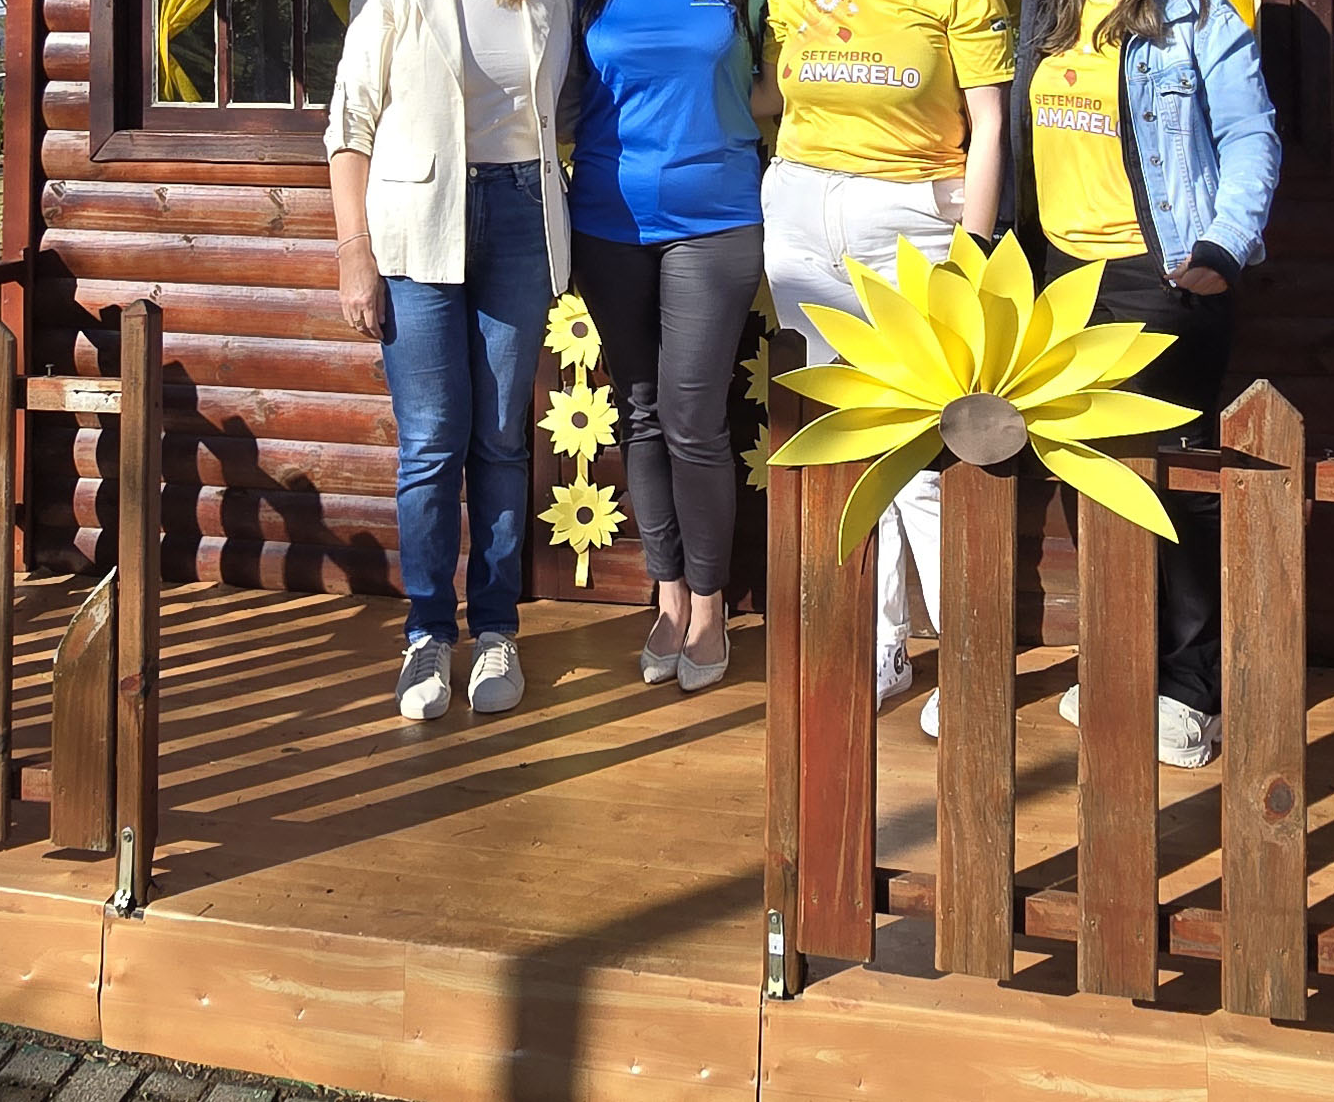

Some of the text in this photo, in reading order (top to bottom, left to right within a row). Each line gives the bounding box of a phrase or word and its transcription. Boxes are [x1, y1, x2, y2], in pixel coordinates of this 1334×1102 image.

[801, 50, 883, 63] SETEMBRO
[799, 62, 920, 88] AMARELO
[1035, 94, 1102, 111] SETEMBRO
